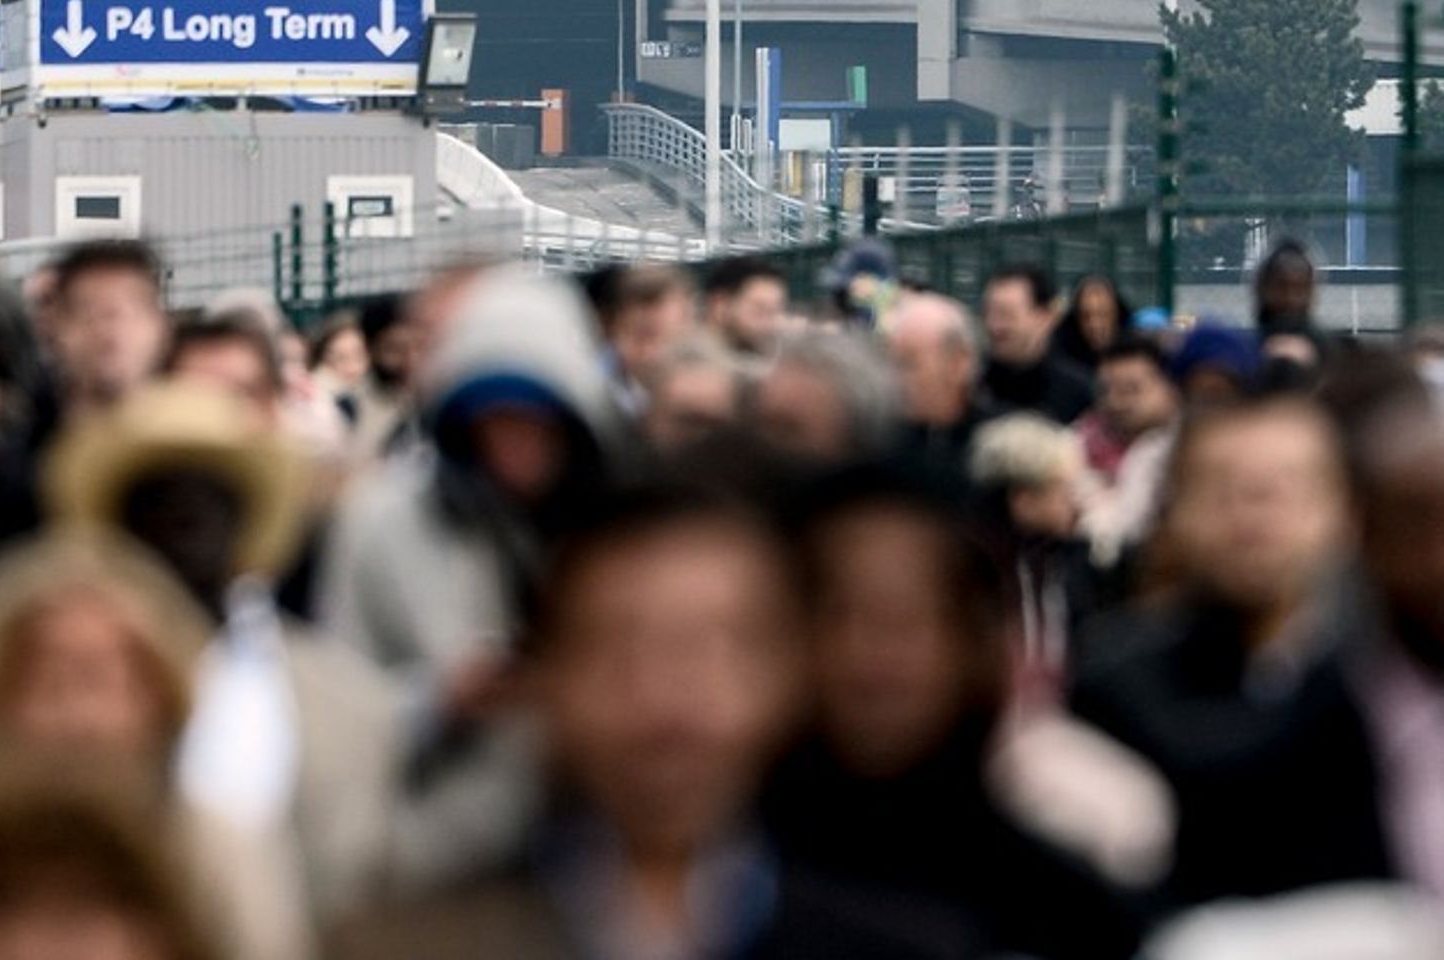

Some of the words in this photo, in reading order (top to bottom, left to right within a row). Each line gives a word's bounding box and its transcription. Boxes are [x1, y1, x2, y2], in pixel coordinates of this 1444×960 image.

[107, 7, 155, 41] P4
[163, 7, 255, 48] Long
[264, 7, 355, 40] Term
